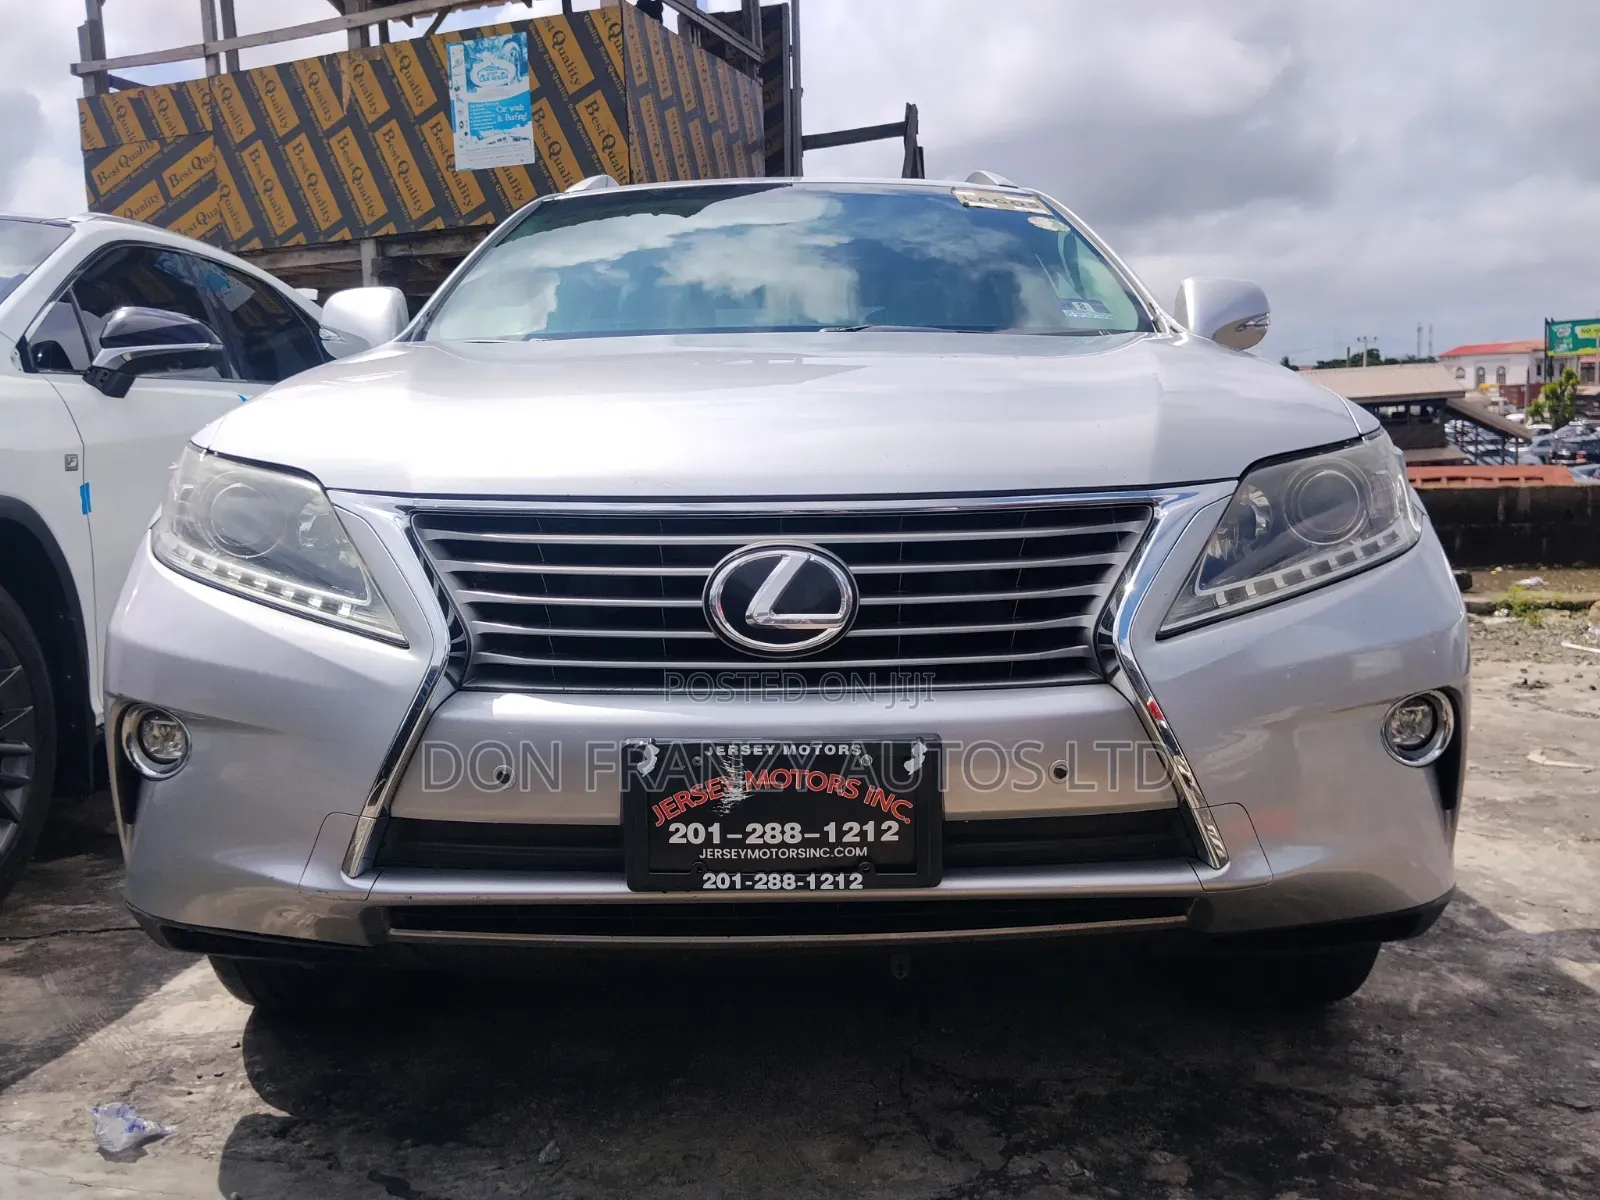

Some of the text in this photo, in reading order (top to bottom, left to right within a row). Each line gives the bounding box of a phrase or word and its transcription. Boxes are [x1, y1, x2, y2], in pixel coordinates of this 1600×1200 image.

[704, 744, 862, 756] JERSEY MOTORS
[745, 768, 862, 799] MOTORS
[699, 846, 868, 860] JERSEYMOTORSINC.COM
[702, 872, 864, 891] 201-288-1212
